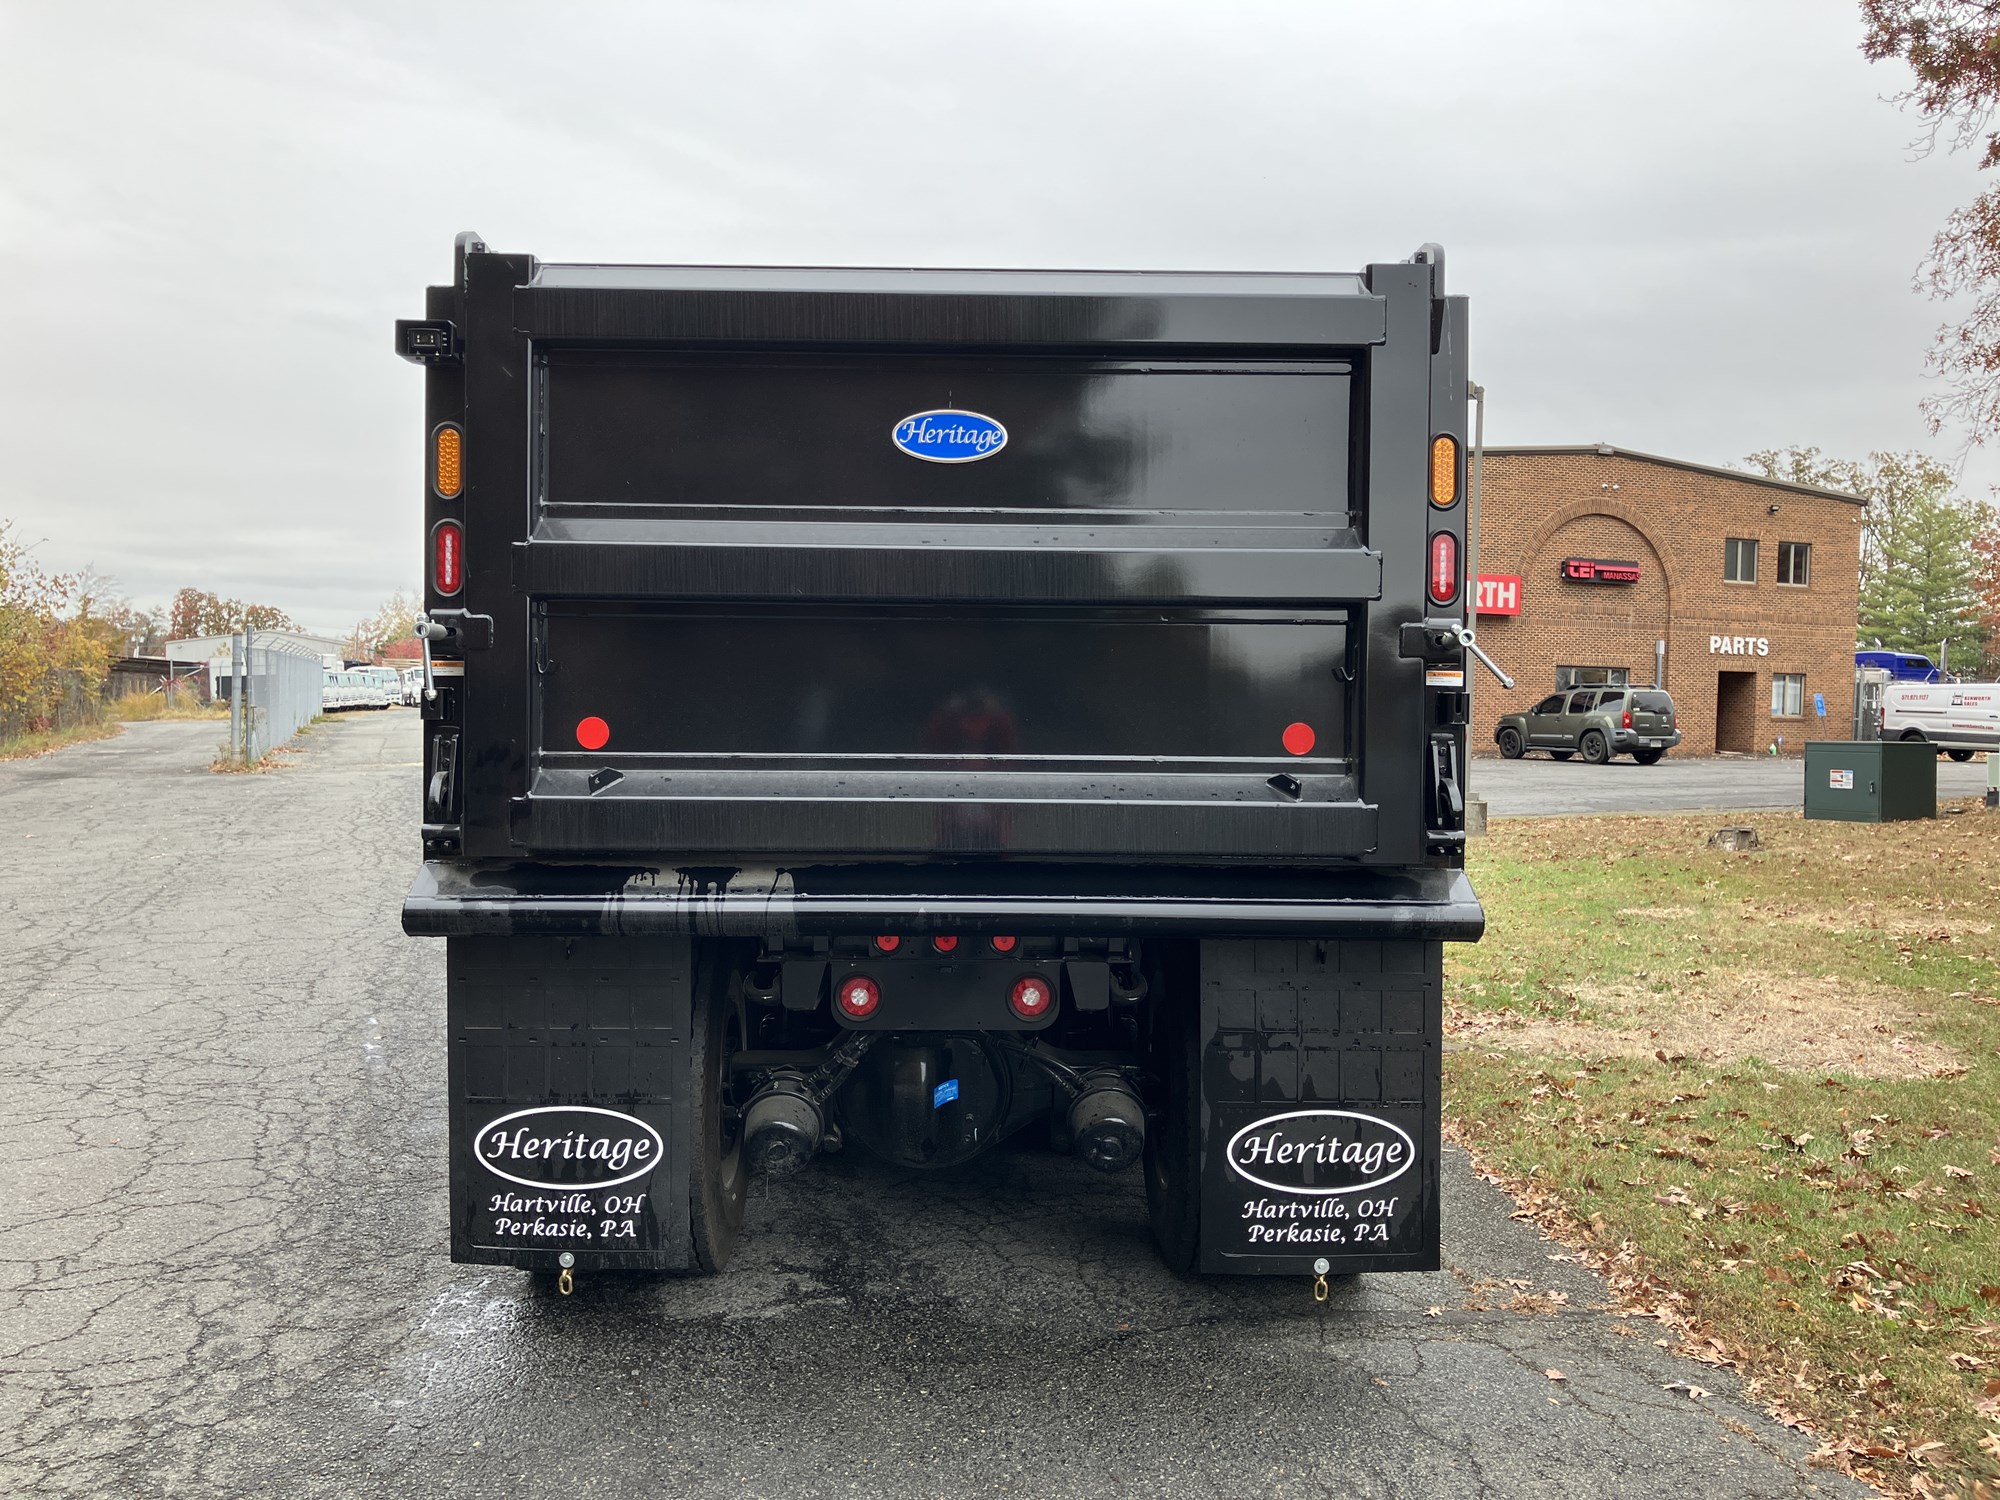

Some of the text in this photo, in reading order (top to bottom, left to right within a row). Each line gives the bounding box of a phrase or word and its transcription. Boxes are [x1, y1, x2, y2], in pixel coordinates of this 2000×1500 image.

[900, 418, 1001, 452] Heritage
[1709, 635, 1769, 656] PARTS
[486, 1127, 650, 1170] Heritage
[1239, 1132, 1402, 1174] Heritage
[488, 1192, 647, 1216] Hartville, OH
[1241, 1197, 1399, 1220] Hartville, OH
[494, 1216, 637, 1240] Perkasie, PA
[1248, 1221, 1390, 1244] Perkasie, PA
